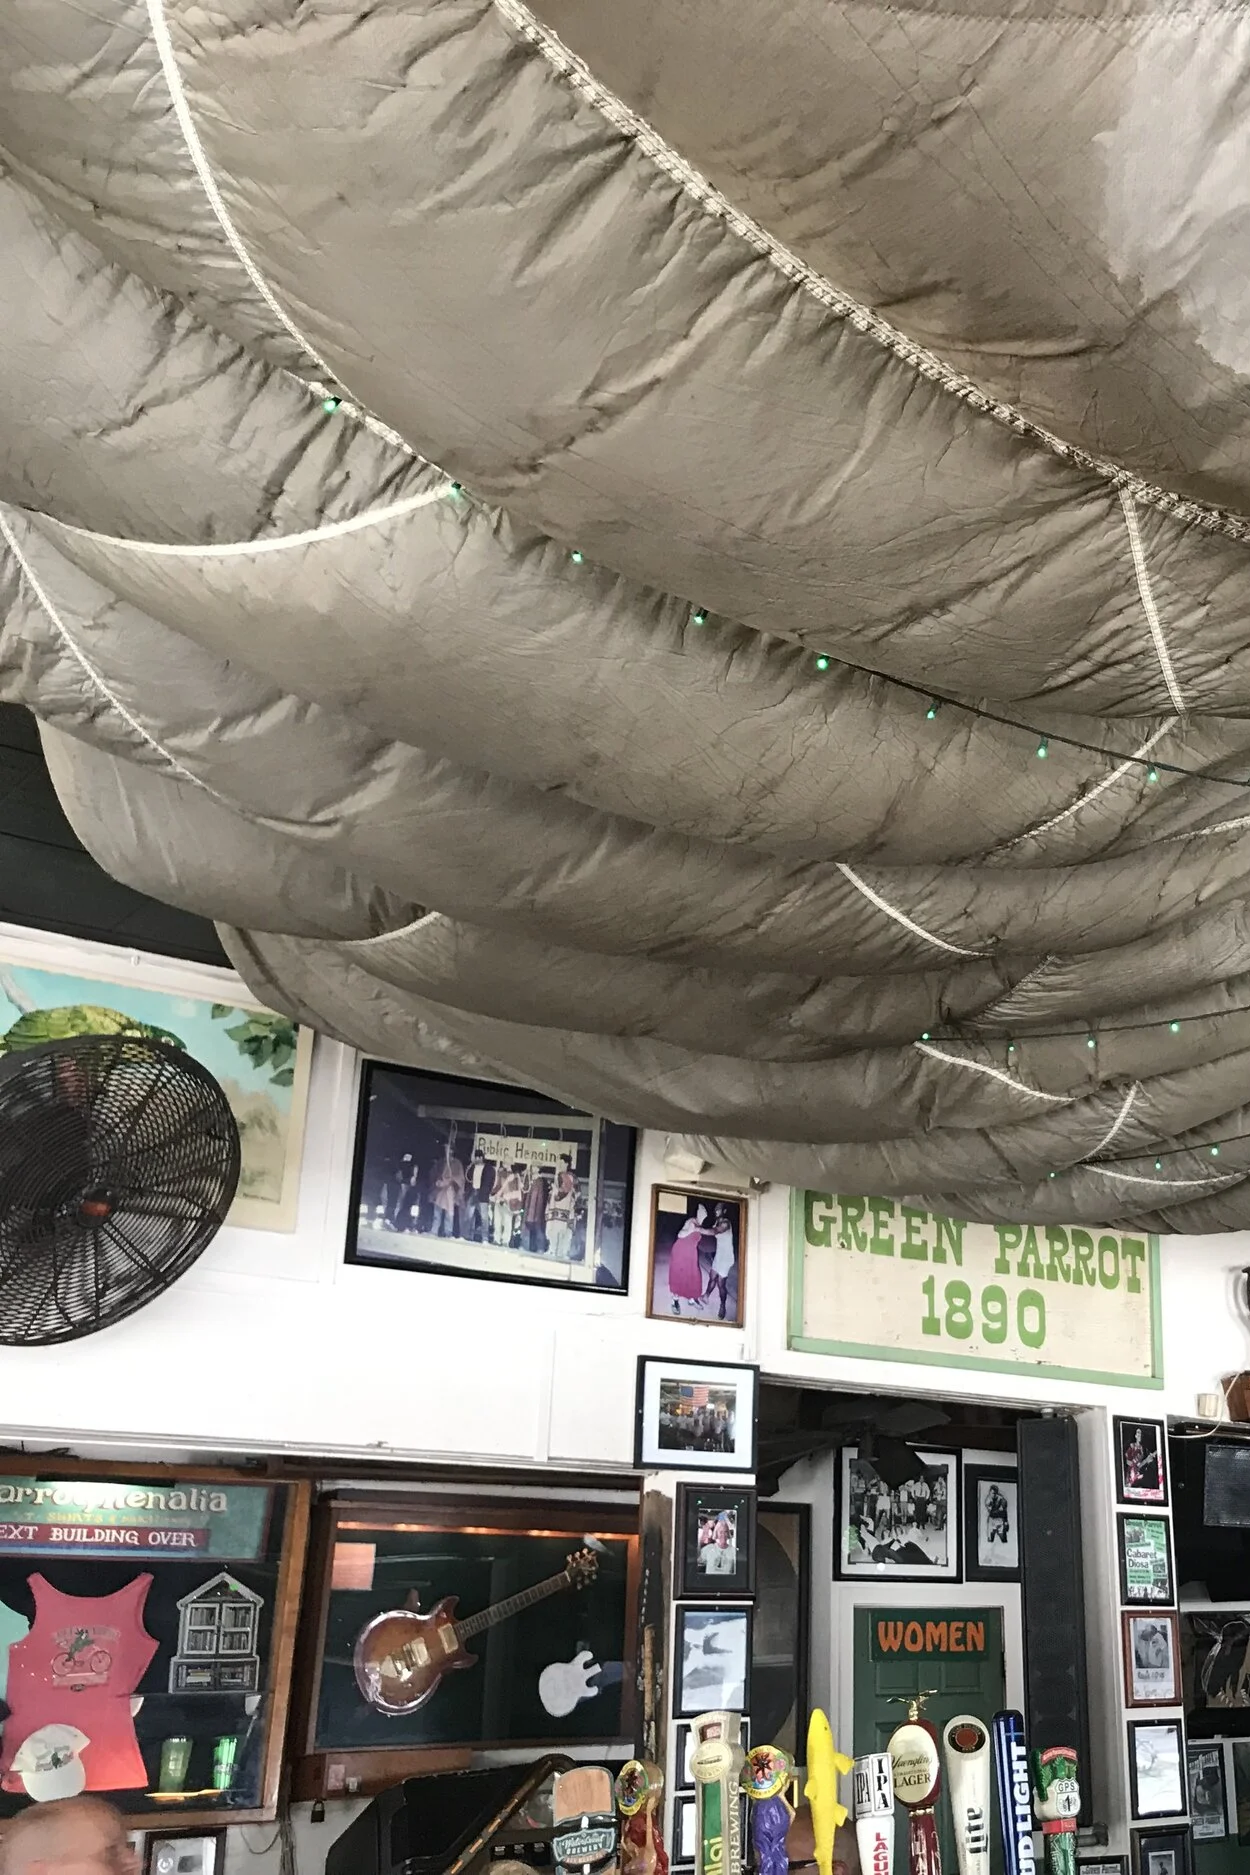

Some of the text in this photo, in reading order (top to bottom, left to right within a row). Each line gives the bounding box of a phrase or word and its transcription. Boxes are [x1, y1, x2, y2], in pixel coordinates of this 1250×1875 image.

[804, 1189, 1146, 1294] GREEN PARROT
[921, 1274, 1047, 1349] 1890
[0, 1525, 197, 1548] EXT BUILDING OVER
[1127, 1548, 1157, 1559] Cabaret
[1128, 1558, 1149, 1568] Diosa
[877, 1621, 985, 1652] WOMEN
[856, 1771, 871, 1805] IPA
[876, 1758, 889, 1809] IPA
[894, 1773, 931, 1788] LAGER
[1057, 1782, 1075, 1793] GPS
[1010, 1741, 1036, 1875] UD LIGHT
[728, 1781, 740, 1874] BREWING
[566, 1843, 603, 1855] BREWERY
